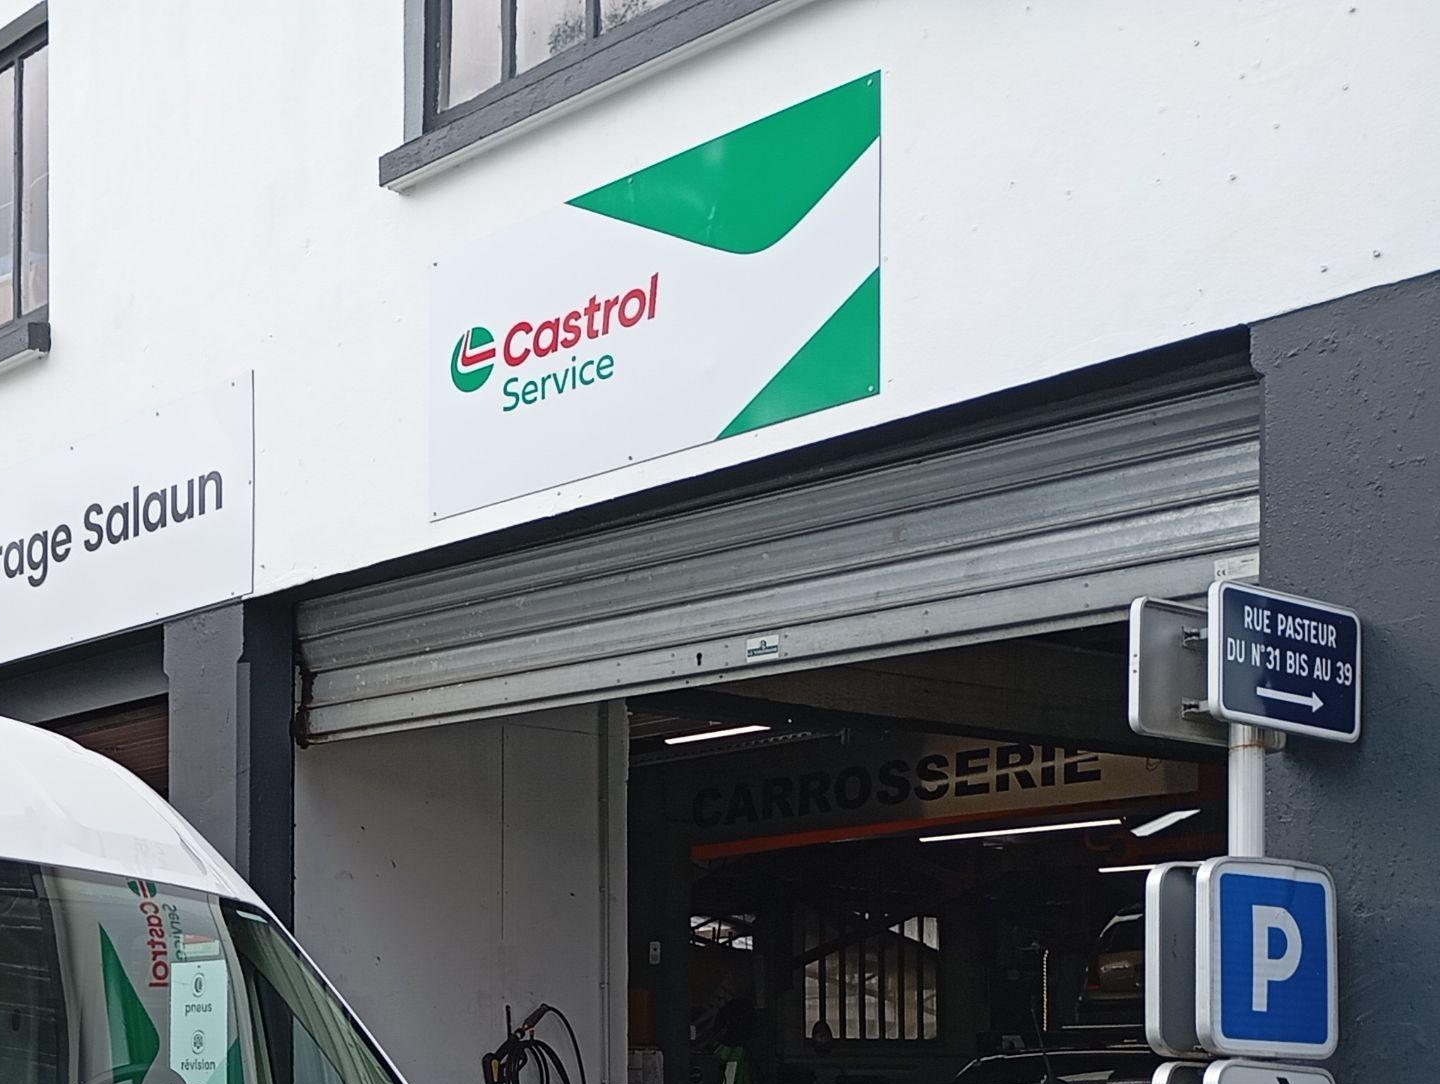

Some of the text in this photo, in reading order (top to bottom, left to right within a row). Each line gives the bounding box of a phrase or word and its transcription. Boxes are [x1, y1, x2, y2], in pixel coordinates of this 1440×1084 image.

[503, 272, 659, 367] Castrol
[503, 355, 615, 412] Service
[83, 470, 223, 552] Salaun
[1244, 605, 1337, 649] RUE PASTEUR
[1227, 637, 1245, 664] DU
[1286, 650, 1309, 677] BIS
[1313, 657, 1331, 682] AU
[1336, 661, 1353, 686] 39
[691, 742, 1103, 830] CARROSSERIE
[1252, 904, 1302, 1012] P
[185, 1002, 212, 1016] pneus
[181, 1059, 215, 1071] révision
